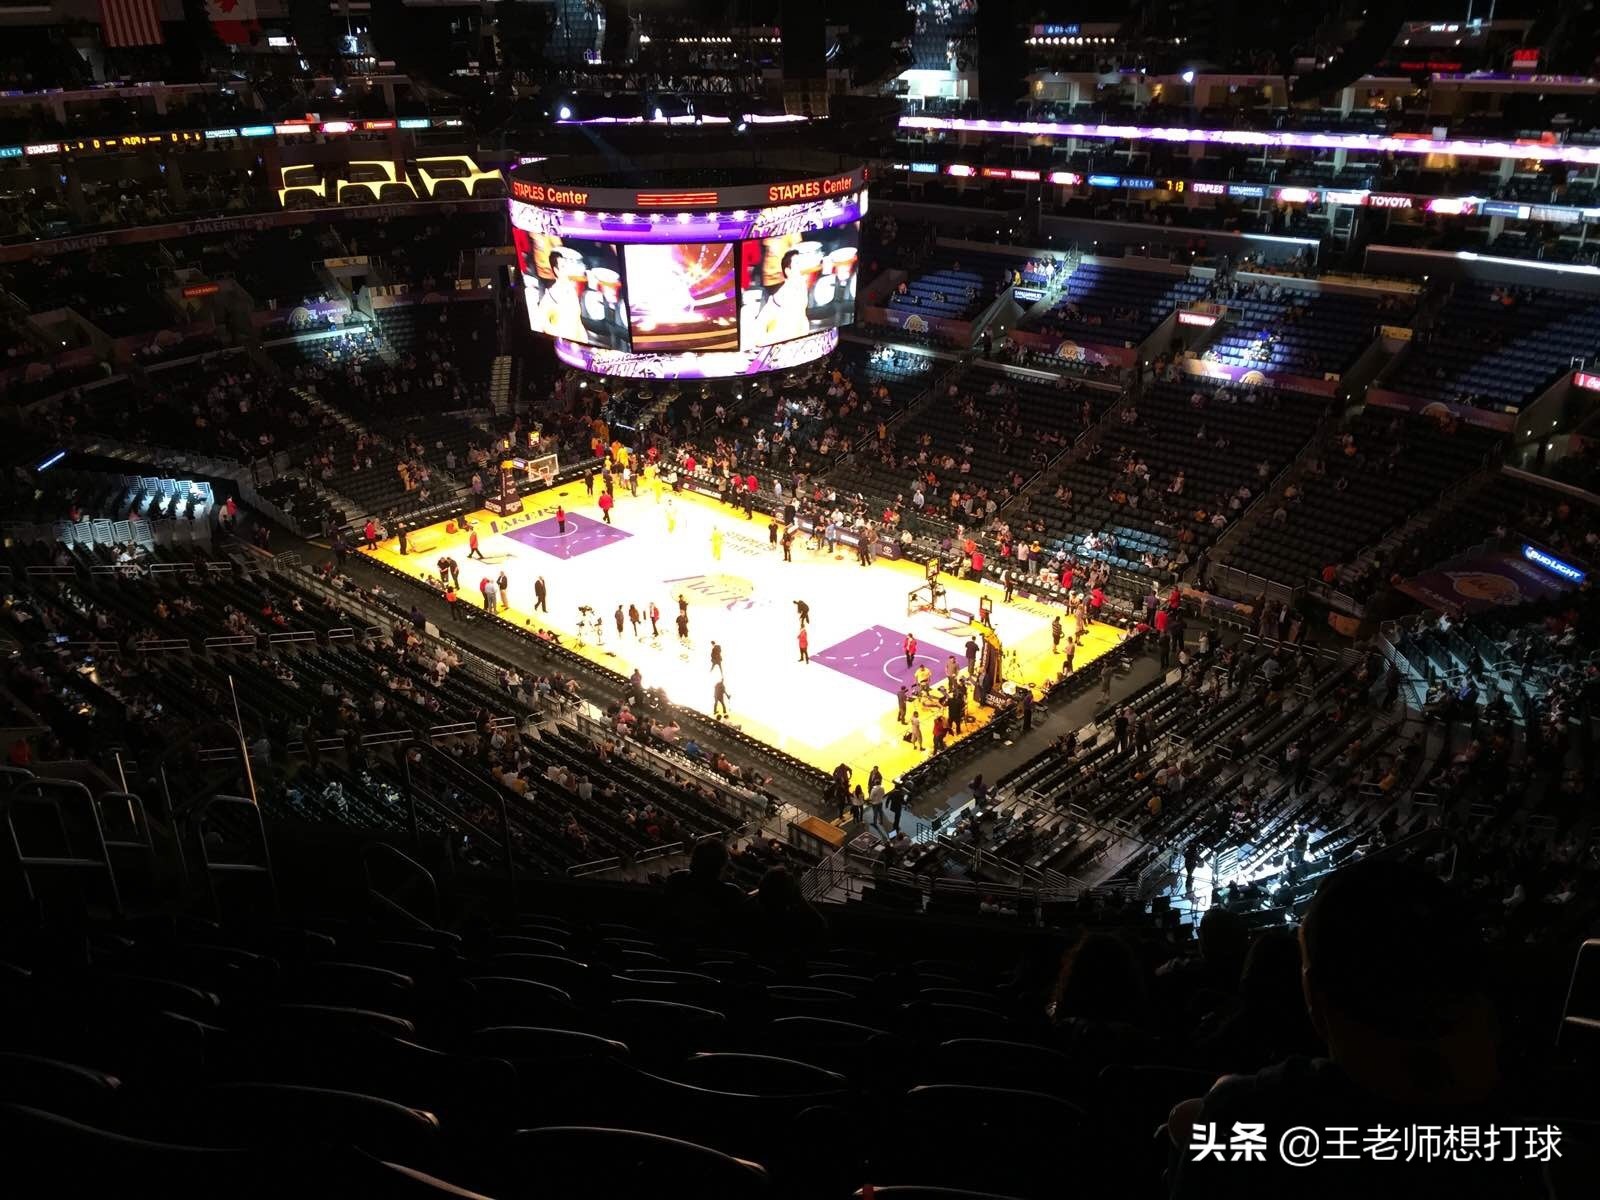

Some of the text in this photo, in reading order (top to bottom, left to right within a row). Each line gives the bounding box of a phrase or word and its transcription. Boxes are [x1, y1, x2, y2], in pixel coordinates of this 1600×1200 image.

[26, 144, 58, 155] STAPLES
[513, 181, 588, 205] STAPLES Center
[769, 177, 852, 201] STAPLES Center
[1193, 184, 1224, 194] STAPLES
[1371, 195, 1413, 208] TOYOTA
